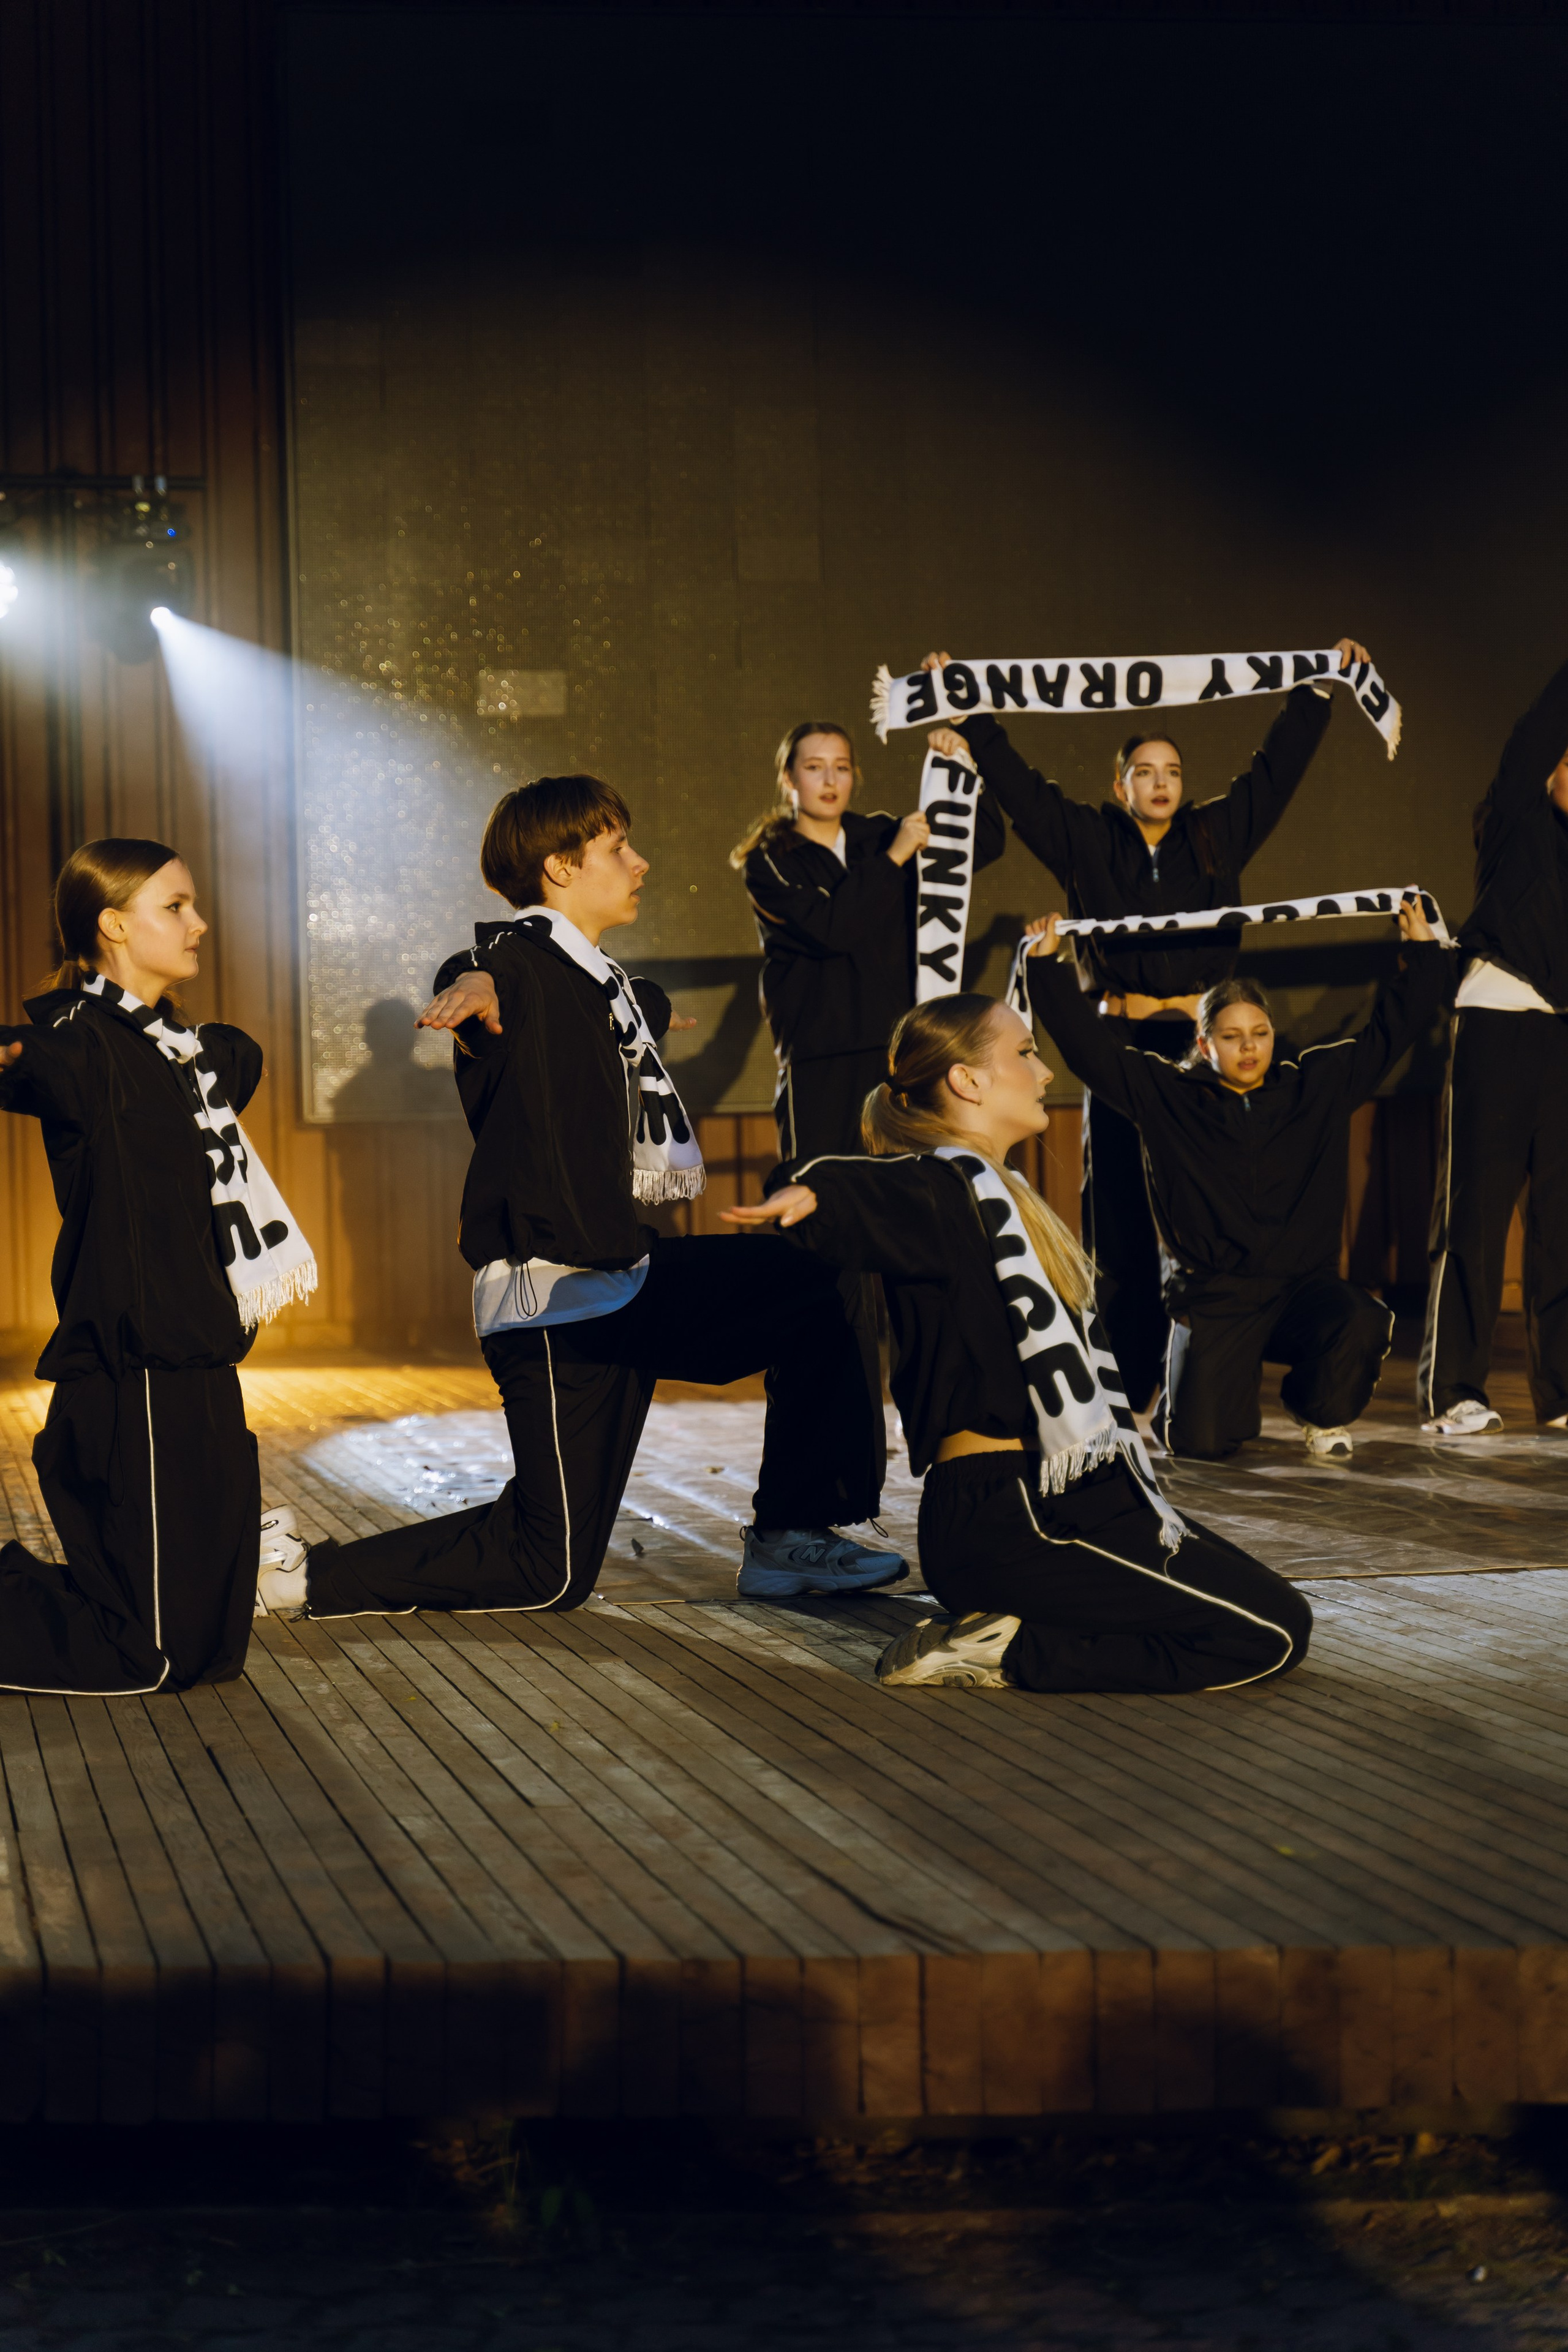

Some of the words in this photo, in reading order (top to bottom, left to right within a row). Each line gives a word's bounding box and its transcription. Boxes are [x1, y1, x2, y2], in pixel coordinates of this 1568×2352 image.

[907, 662, 1163, 723] ORANGE
[919, 756, 978, 982] FUNKY
[800, 1545, 826, 1563] N
